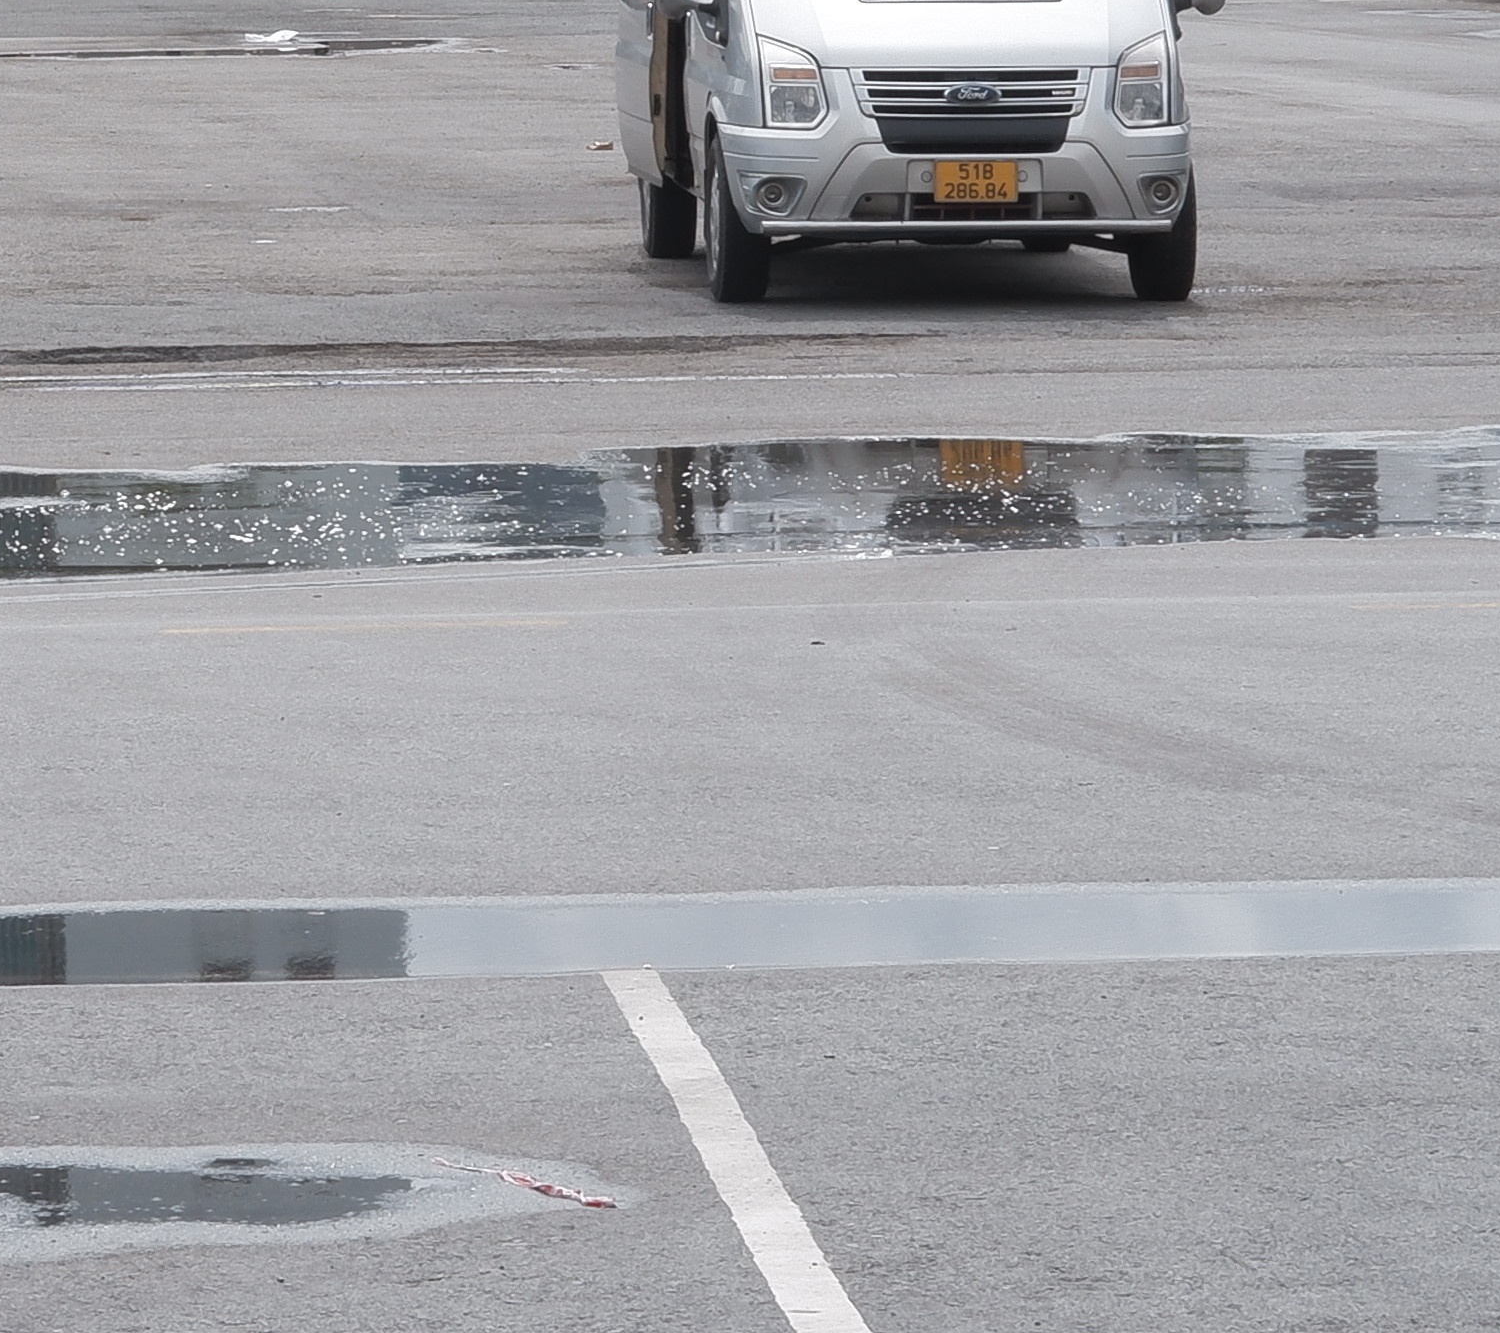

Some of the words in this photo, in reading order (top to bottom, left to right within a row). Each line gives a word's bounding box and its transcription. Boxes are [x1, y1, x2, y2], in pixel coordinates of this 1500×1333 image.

[958, 87, 988, 100] Ford
[959, 164, 993, 180] 51B
[944, 183, 1007, 199] 286.84
